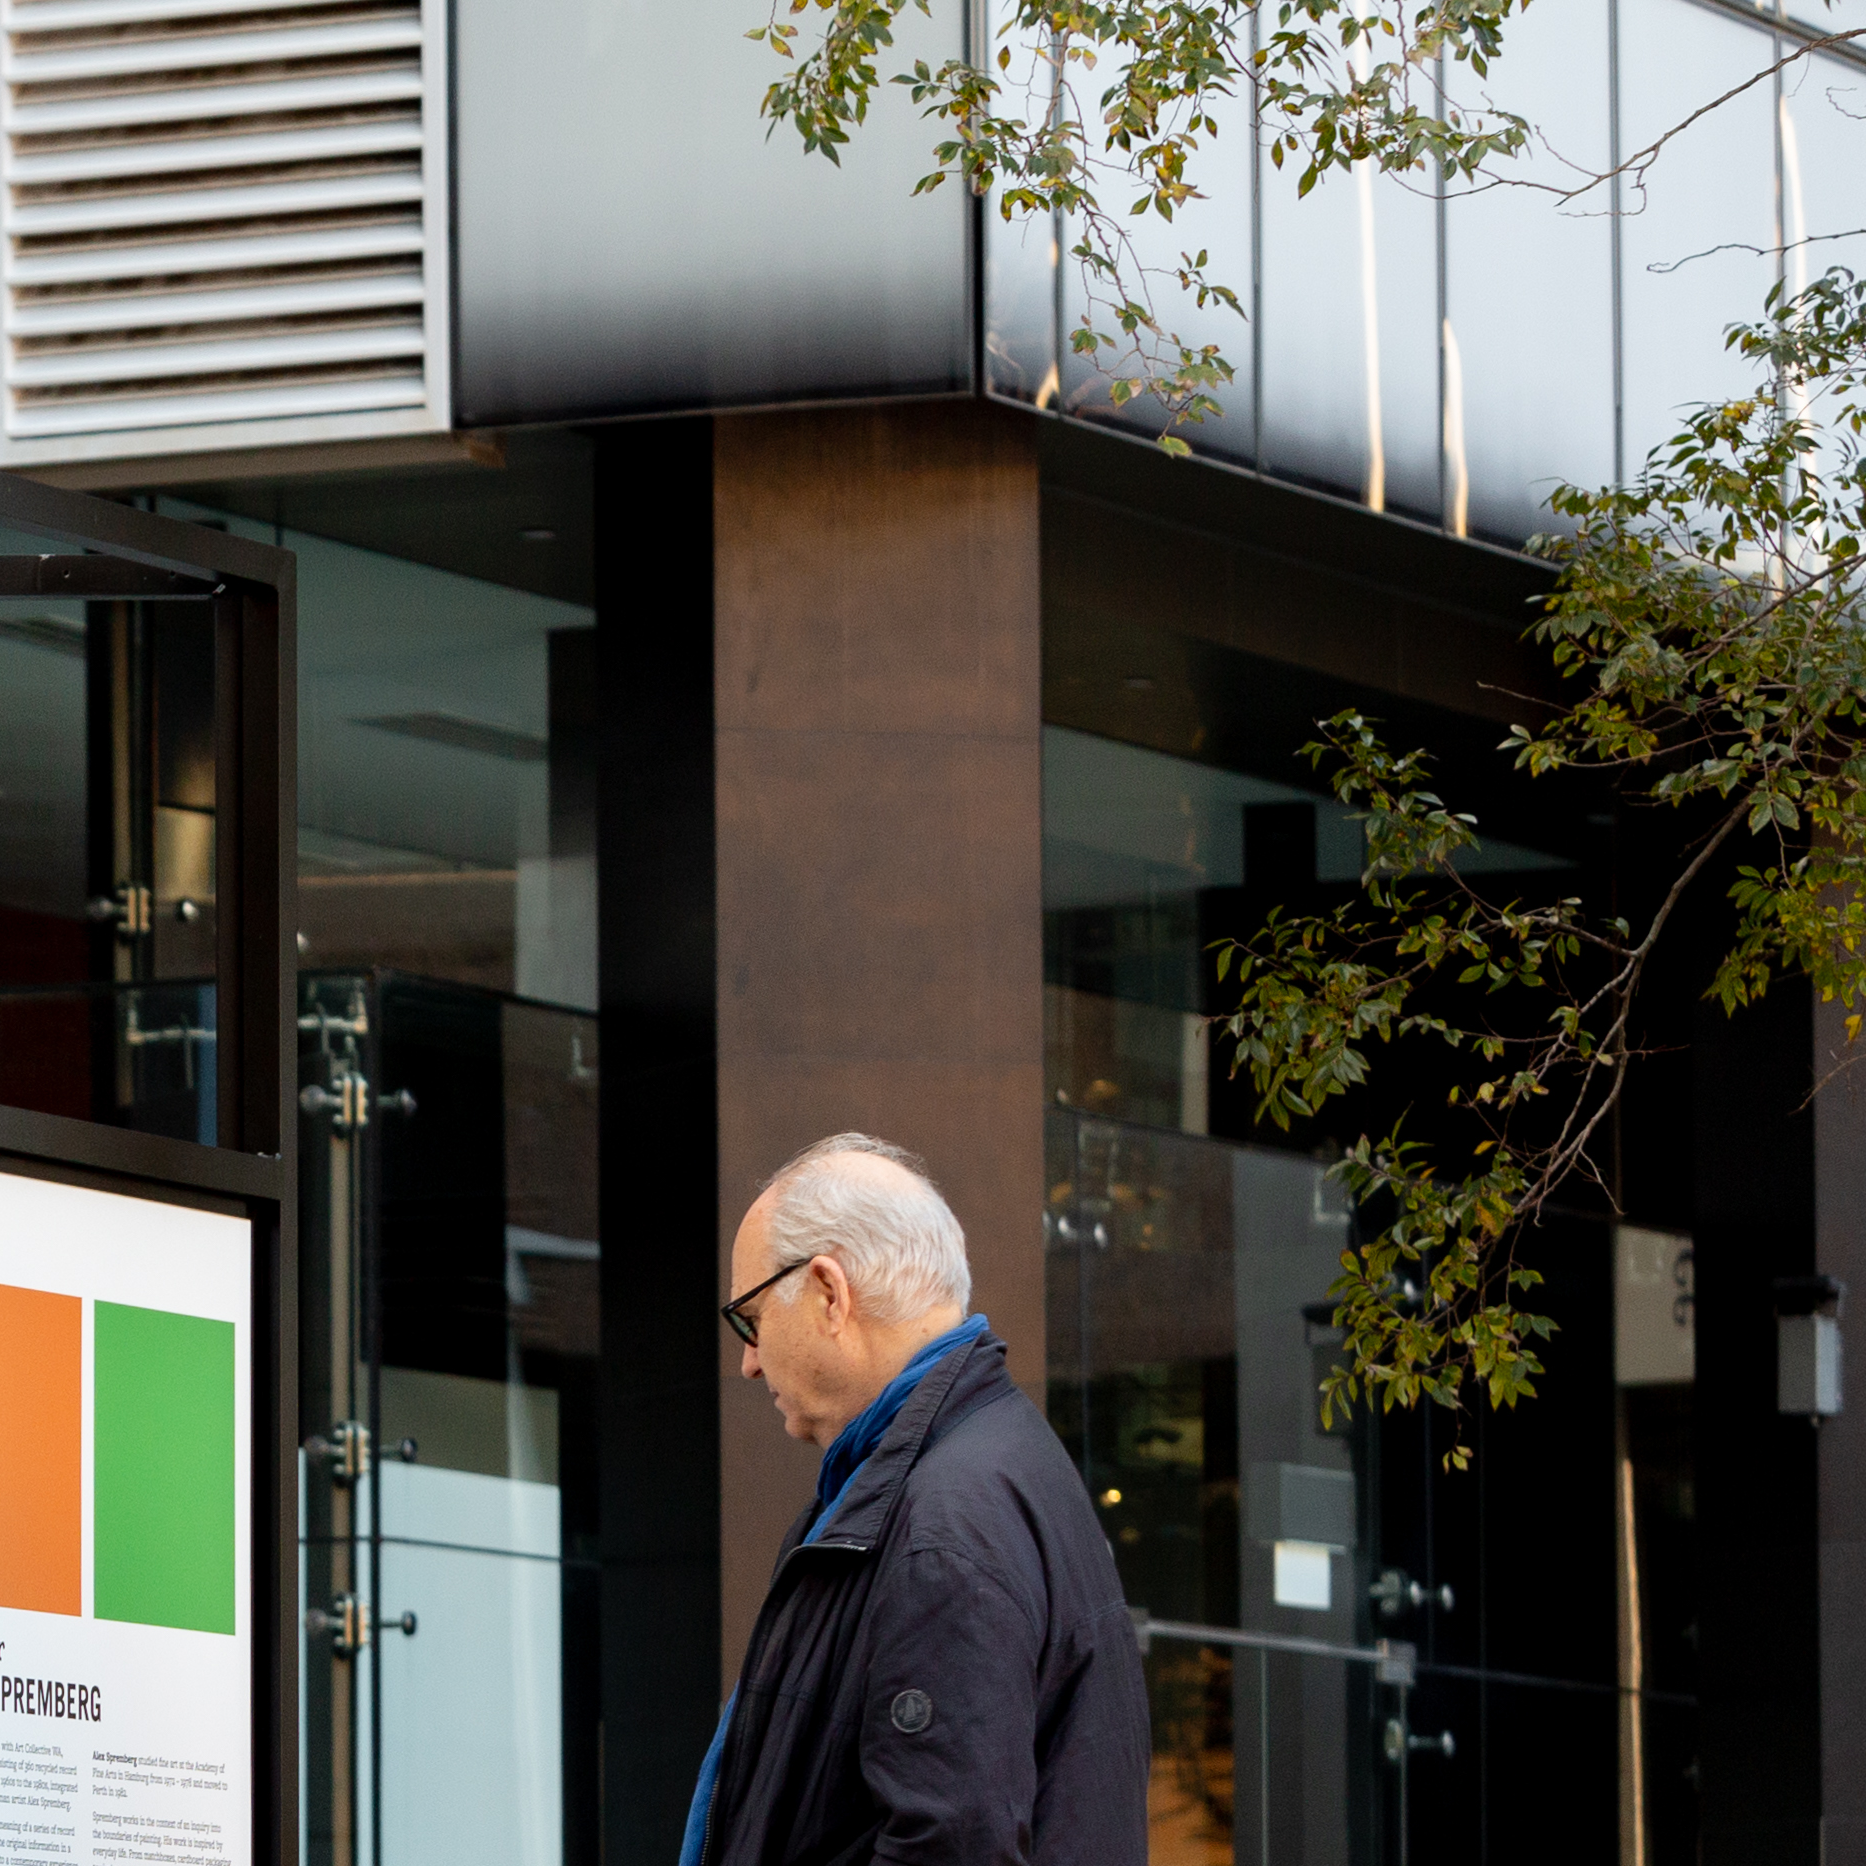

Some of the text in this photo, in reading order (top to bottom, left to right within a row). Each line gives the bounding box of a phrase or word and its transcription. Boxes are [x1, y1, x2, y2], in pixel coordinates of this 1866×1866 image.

[25, 1743, 51, 1757] Collective
[35, 1763, 58, 1776] recycled
[59, 1766, 77, 1777] record
[106, 1752, 137, 1768] Spremberg
[138, 1756, 158, 1768] studied
[195, 1761, 219, 1777] Academy
[50, 1781, 78, 1795] integrated
[124, 1771, 222, 1792] Hamburg moved
[92, 1785, 108, 1797] Perth
[11, 1795, 26, 1806] artist
[33, 1824, 50, 1835] series
[57, 1826, 75, 1837] record
[92, 1811, 210, 1836] Spremberg works context inquiry
[6, 1839, 27, 1852] original
[28, 1840, 60, 1853] information
[102, 1829, 132, 1843] boundaries
[194, 1839, 215, 1852] inspired
[92, 1847, 117, 1861] everyday
[177, 1854, 204, 1866] cardboard
